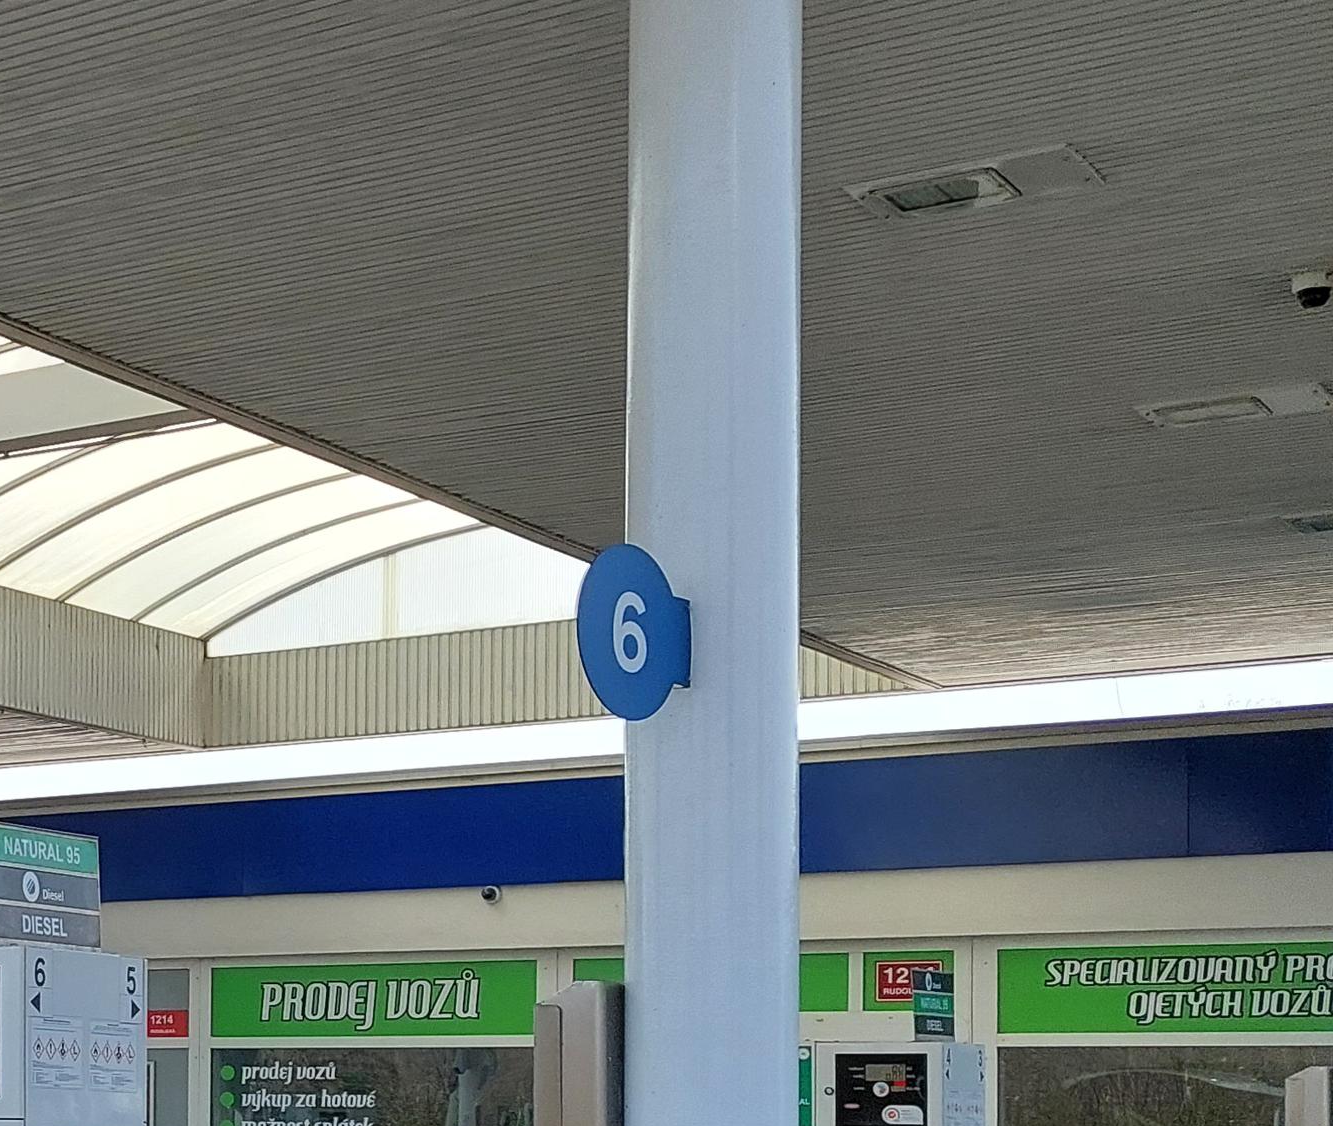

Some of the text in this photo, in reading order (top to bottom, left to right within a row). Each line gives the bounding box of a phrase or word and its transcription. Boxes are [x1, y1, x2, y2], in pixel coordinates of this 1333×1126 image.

[612, 591, 648, 674] 6
[4, 836, 81, 865] NATURAL 95
[42, 888, 64, 902] Diesel
[22, 914, 68, 937] DIESEL
[34, 957, 46, 987] 6
[126, 967, 136, 995] 5
[1045, 951, 1277, 986] SPECIALIZOVANÝ
[261, 968, 481, 1030] PRODEJ VOZŮ
[883, 988, 912, 996] RUDOL
[1129, 984, 1333, 1025] OJETÝCH VOZŮ
[150, 1014, 174, 1025] 1214
[241, 1061, 336, 1085] prodej vozů
[241, 1089, 376, 1112] výkup za hotové
